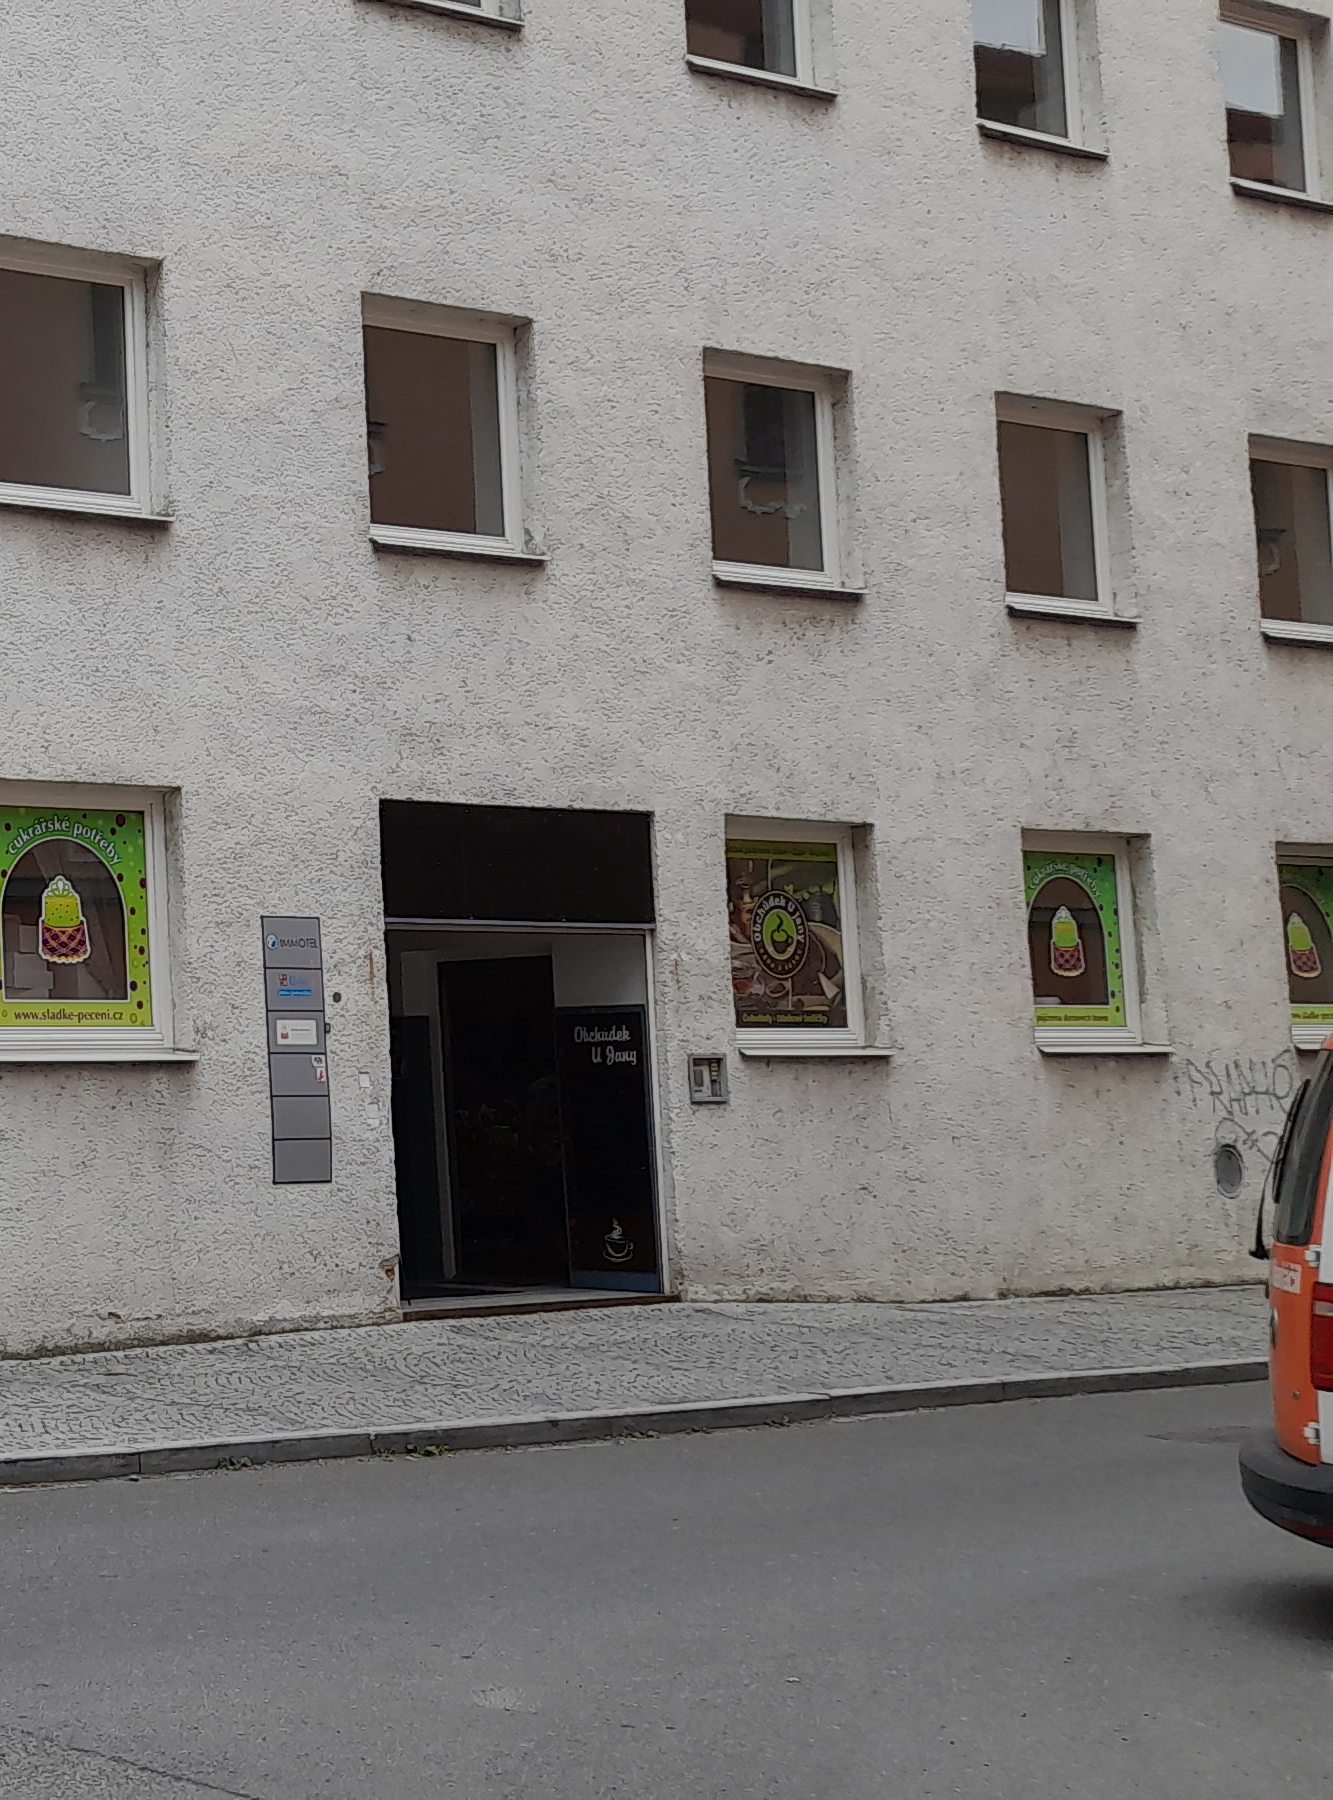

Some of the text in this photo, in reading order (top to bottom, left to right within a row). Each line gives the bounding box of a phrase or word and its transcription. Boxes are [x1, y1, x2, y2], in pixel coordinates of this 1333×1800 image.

[8, 815, 122, 865] cukrářské potřeby
[14, 1008, 124, 1023] www.sladke-peceni.cz
[591, 1045, 637, 1065] U Jany
